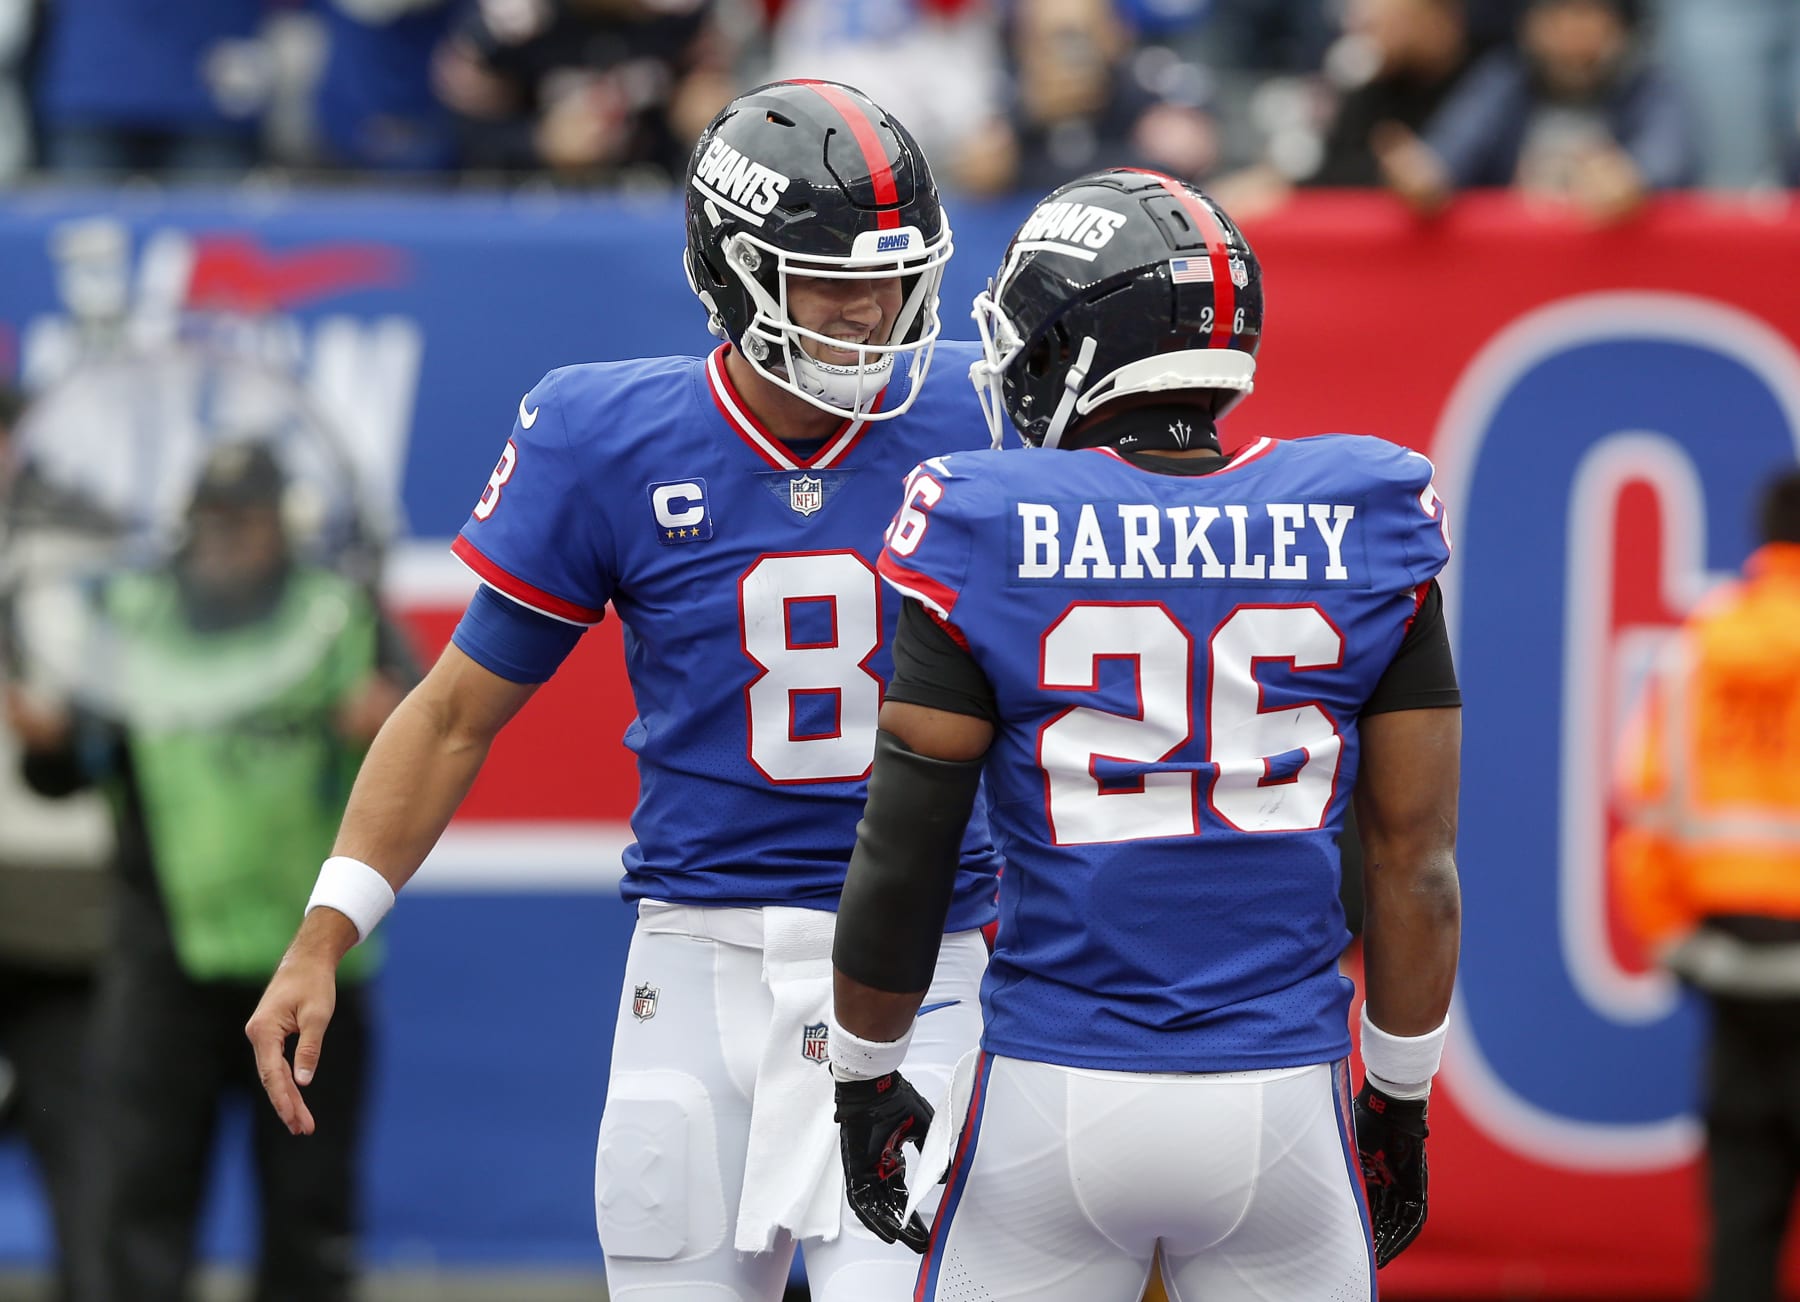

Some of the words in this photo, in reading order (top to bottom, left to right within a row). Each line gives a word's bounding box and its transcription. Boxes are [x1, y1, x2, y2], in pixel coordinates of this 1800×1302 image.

[697, 137, 790, 214] GIANTS
[877, 233, 909, 249] GIANTS
[652, 483, 706, 528] C
[796, 493, 817, 508] NFL
[1018, 502, 1355, 580] BARKLEY
[739, 548, 884, 785] 8
[1037, 600, 1344, 847] 26
[635, 999, 653, 1015] NFL
